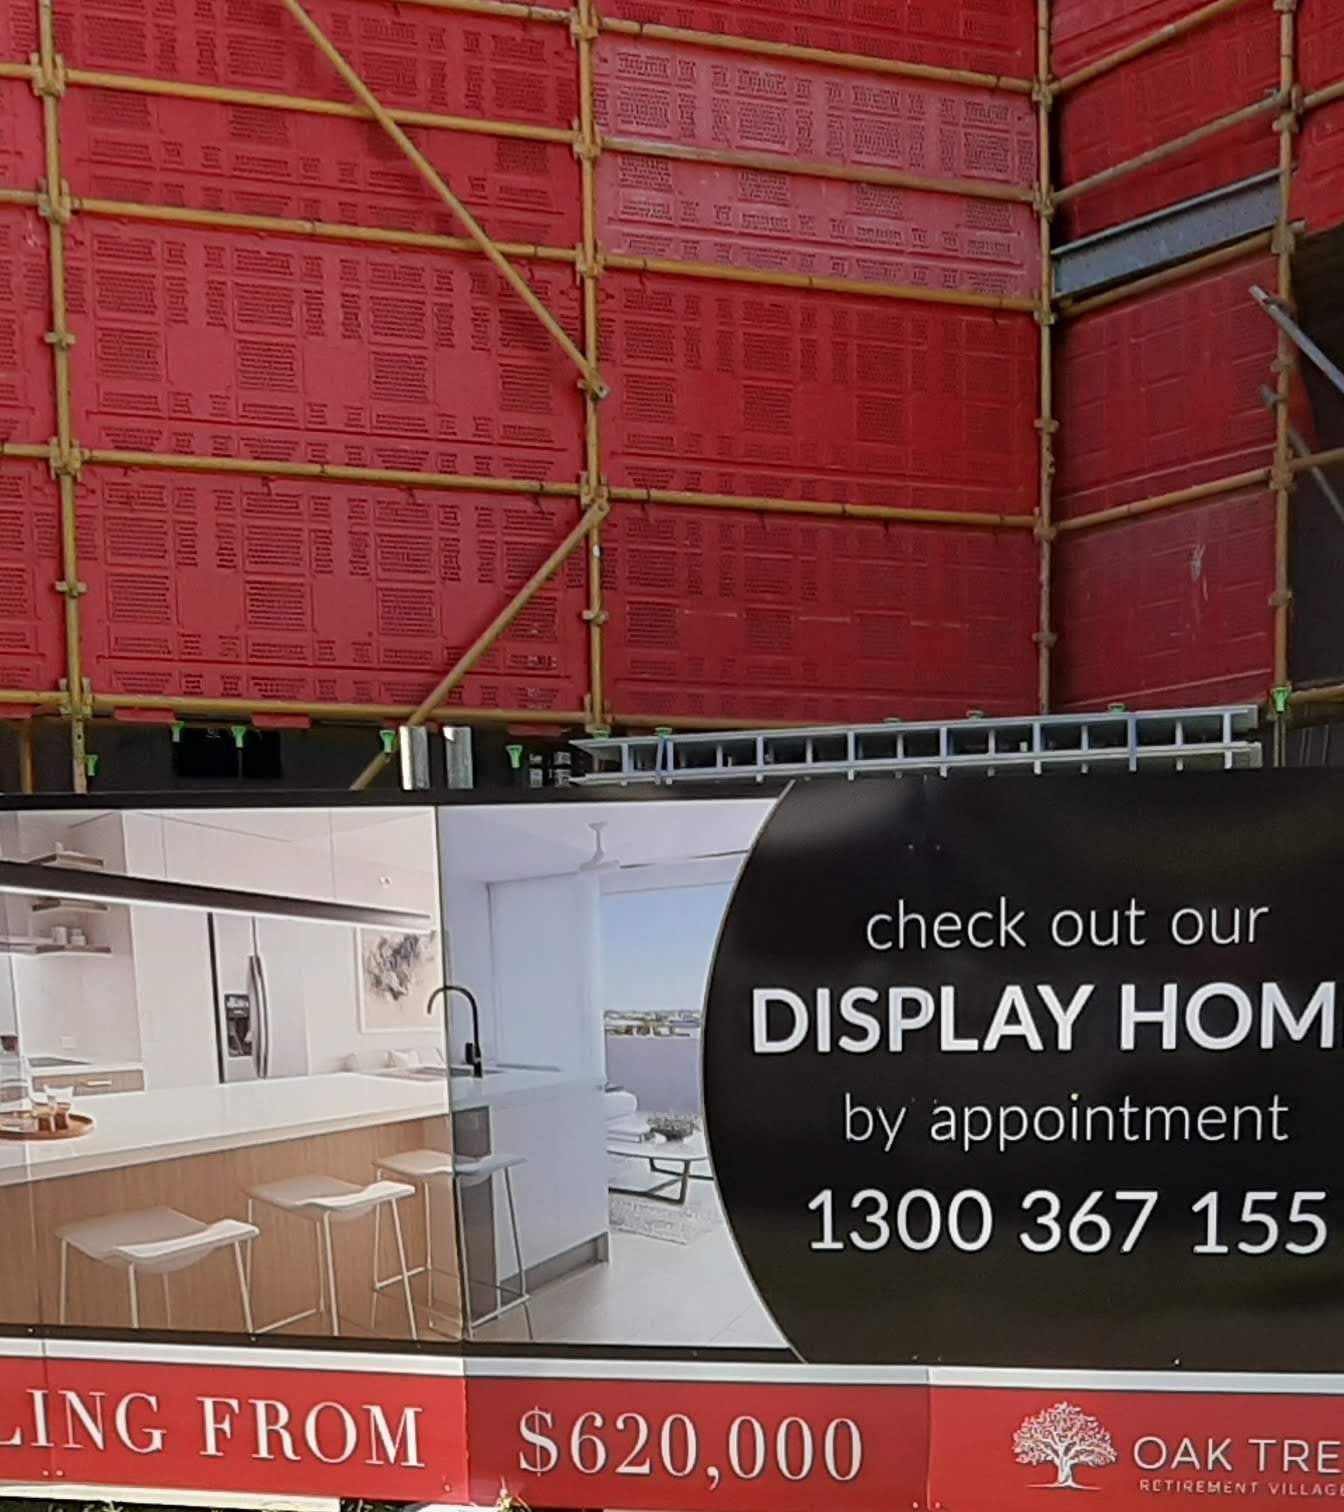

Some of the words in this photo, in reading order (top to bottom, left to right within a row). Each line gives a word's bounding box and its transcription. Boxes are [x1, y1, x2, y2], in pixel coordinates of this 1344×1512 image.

[866, 896, 1027, 951] check
[1050, 896, 1147, 949] out
[1170, 902, 1270, 947] our
[751, 981, 1096, 1056] DISPLAY
[844, 1093, 908, 1153] by
[930, 1091, 1290, 1153] appointment
[807, 1187, 994, 1254] 1300
[1019, 1188, 1160, 1255] 367
[1190, 1189, 1330, 1257] 155
[196, 1395, 427, 1470] FROM
[518, 1405, 864, 1492] $620,000
[1132, 1435, 1235, 1473] OAK
[1139, 1479, 1259, 1495] RETIREMENT
